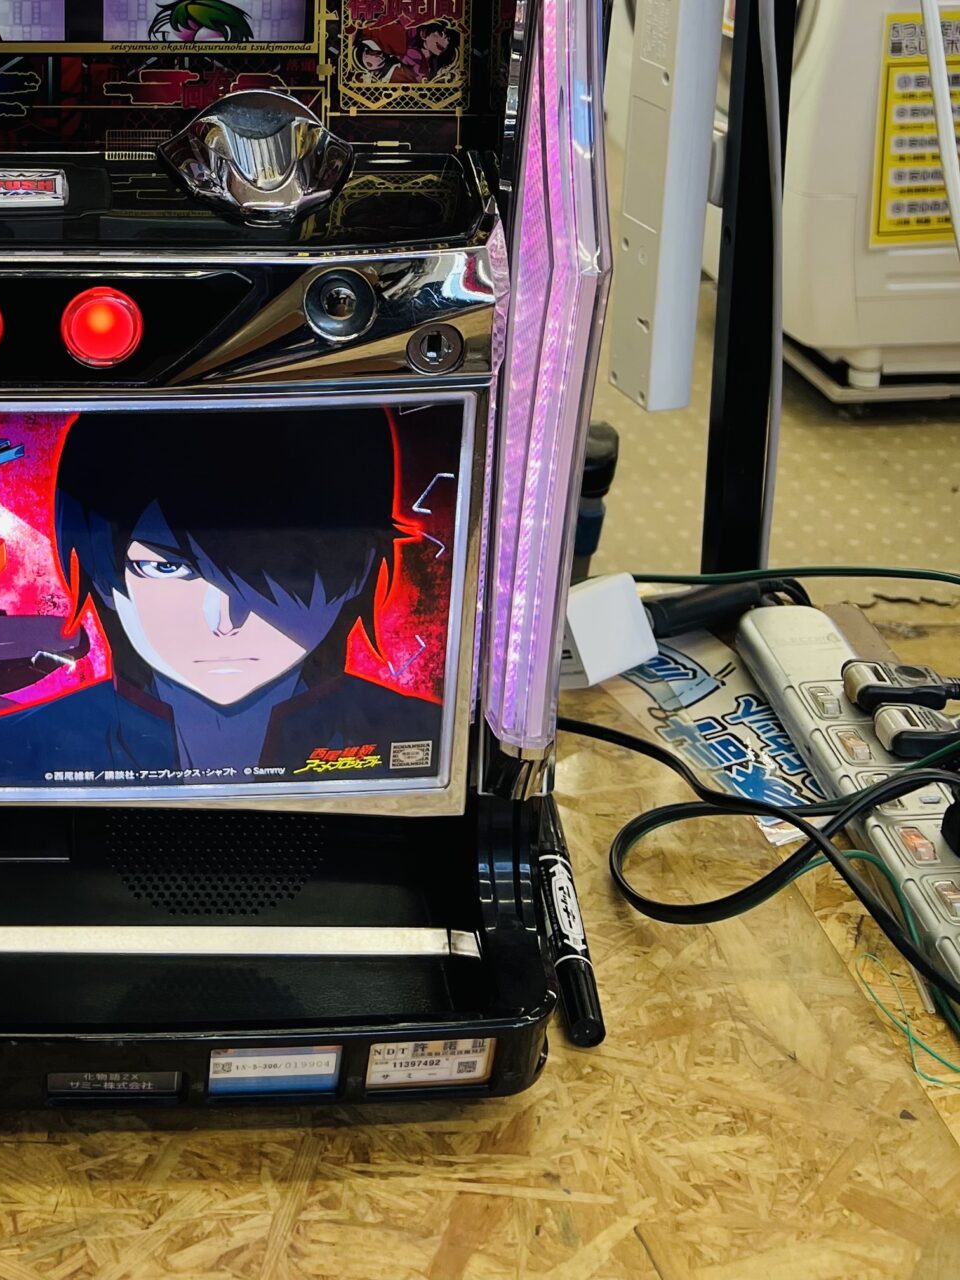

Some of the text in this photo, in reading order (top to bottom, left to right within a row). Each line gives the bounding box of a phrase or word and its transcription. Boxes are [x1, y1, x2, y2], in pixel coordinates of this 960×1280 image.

[309, 743, 378, 761] 西尾維新
[244, 766, 286, 777] ©Sammy
[373, 1047, 409, 1056] NDT
[393, 1060, 441, 1069] 11397492
[70, 1081, 153, 1090] サミー株式会社
